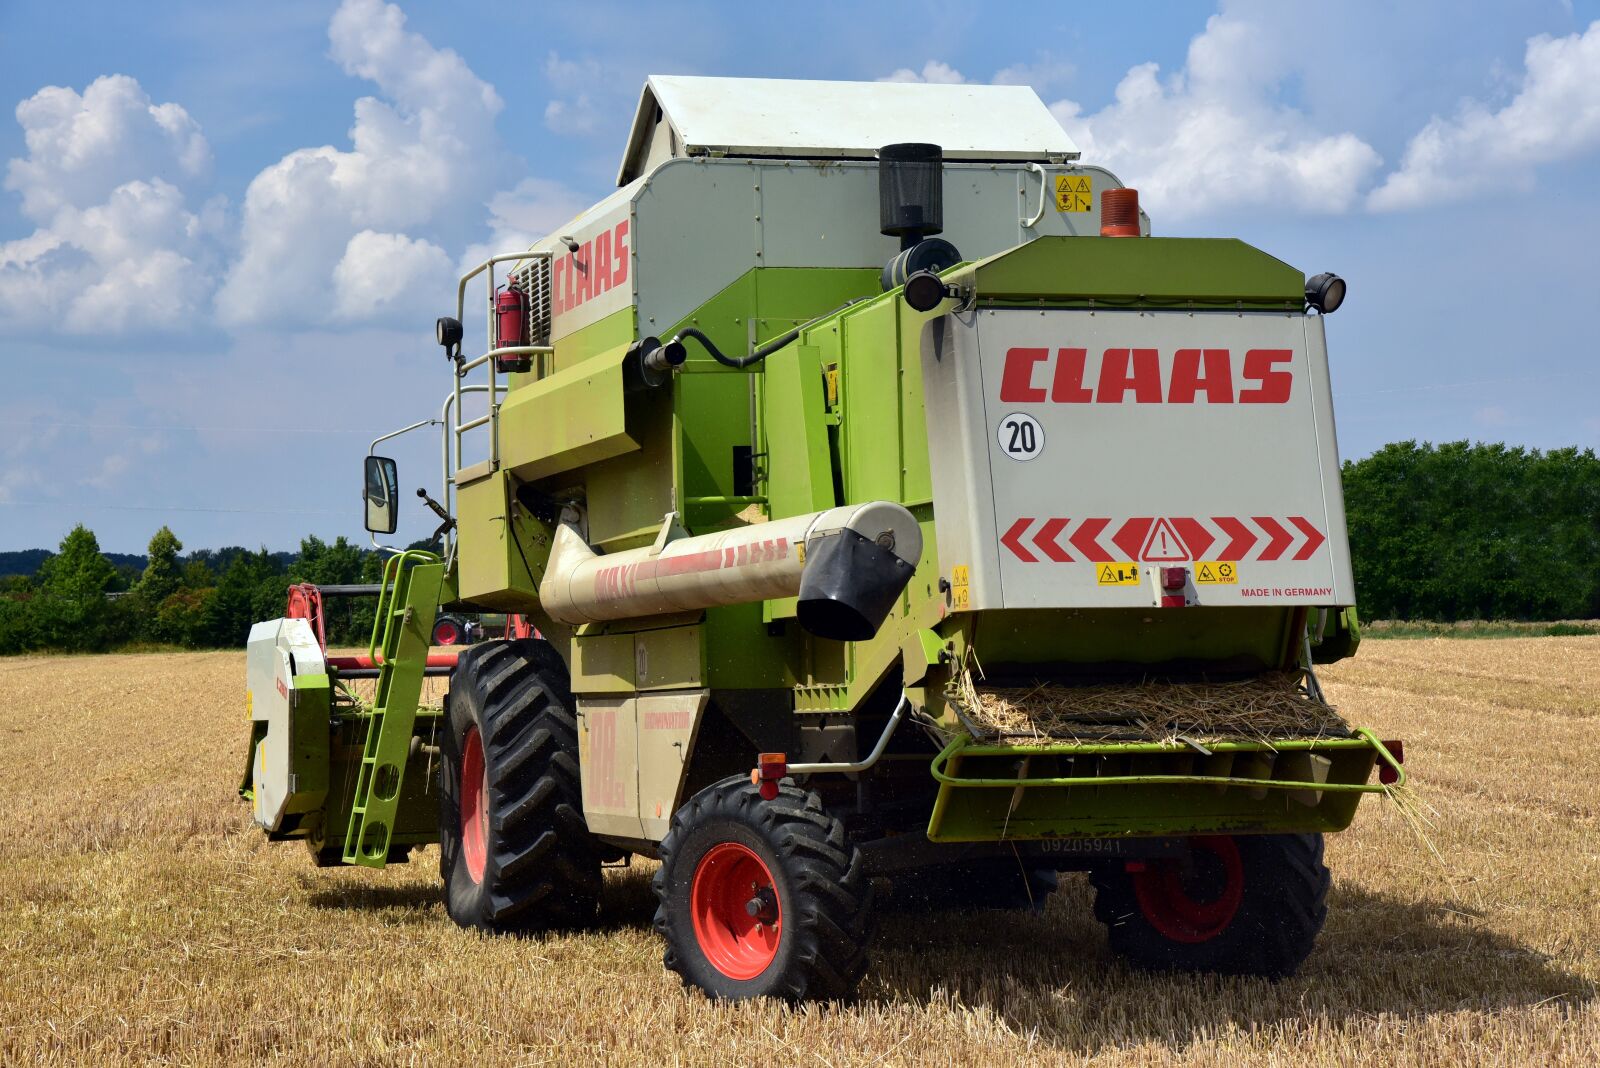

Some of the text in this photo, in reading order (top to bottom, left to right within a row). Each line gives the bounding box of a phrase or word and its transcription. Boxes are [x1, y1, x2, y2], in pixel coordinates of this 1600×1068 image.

[552, 219, 629, 317] CLAAS
[1000, 348, 1293, 403] CLAAS
[1006, 421, 1036, 453] 20
[1241, 588, 1332, 597] MADE IN GERMANY
